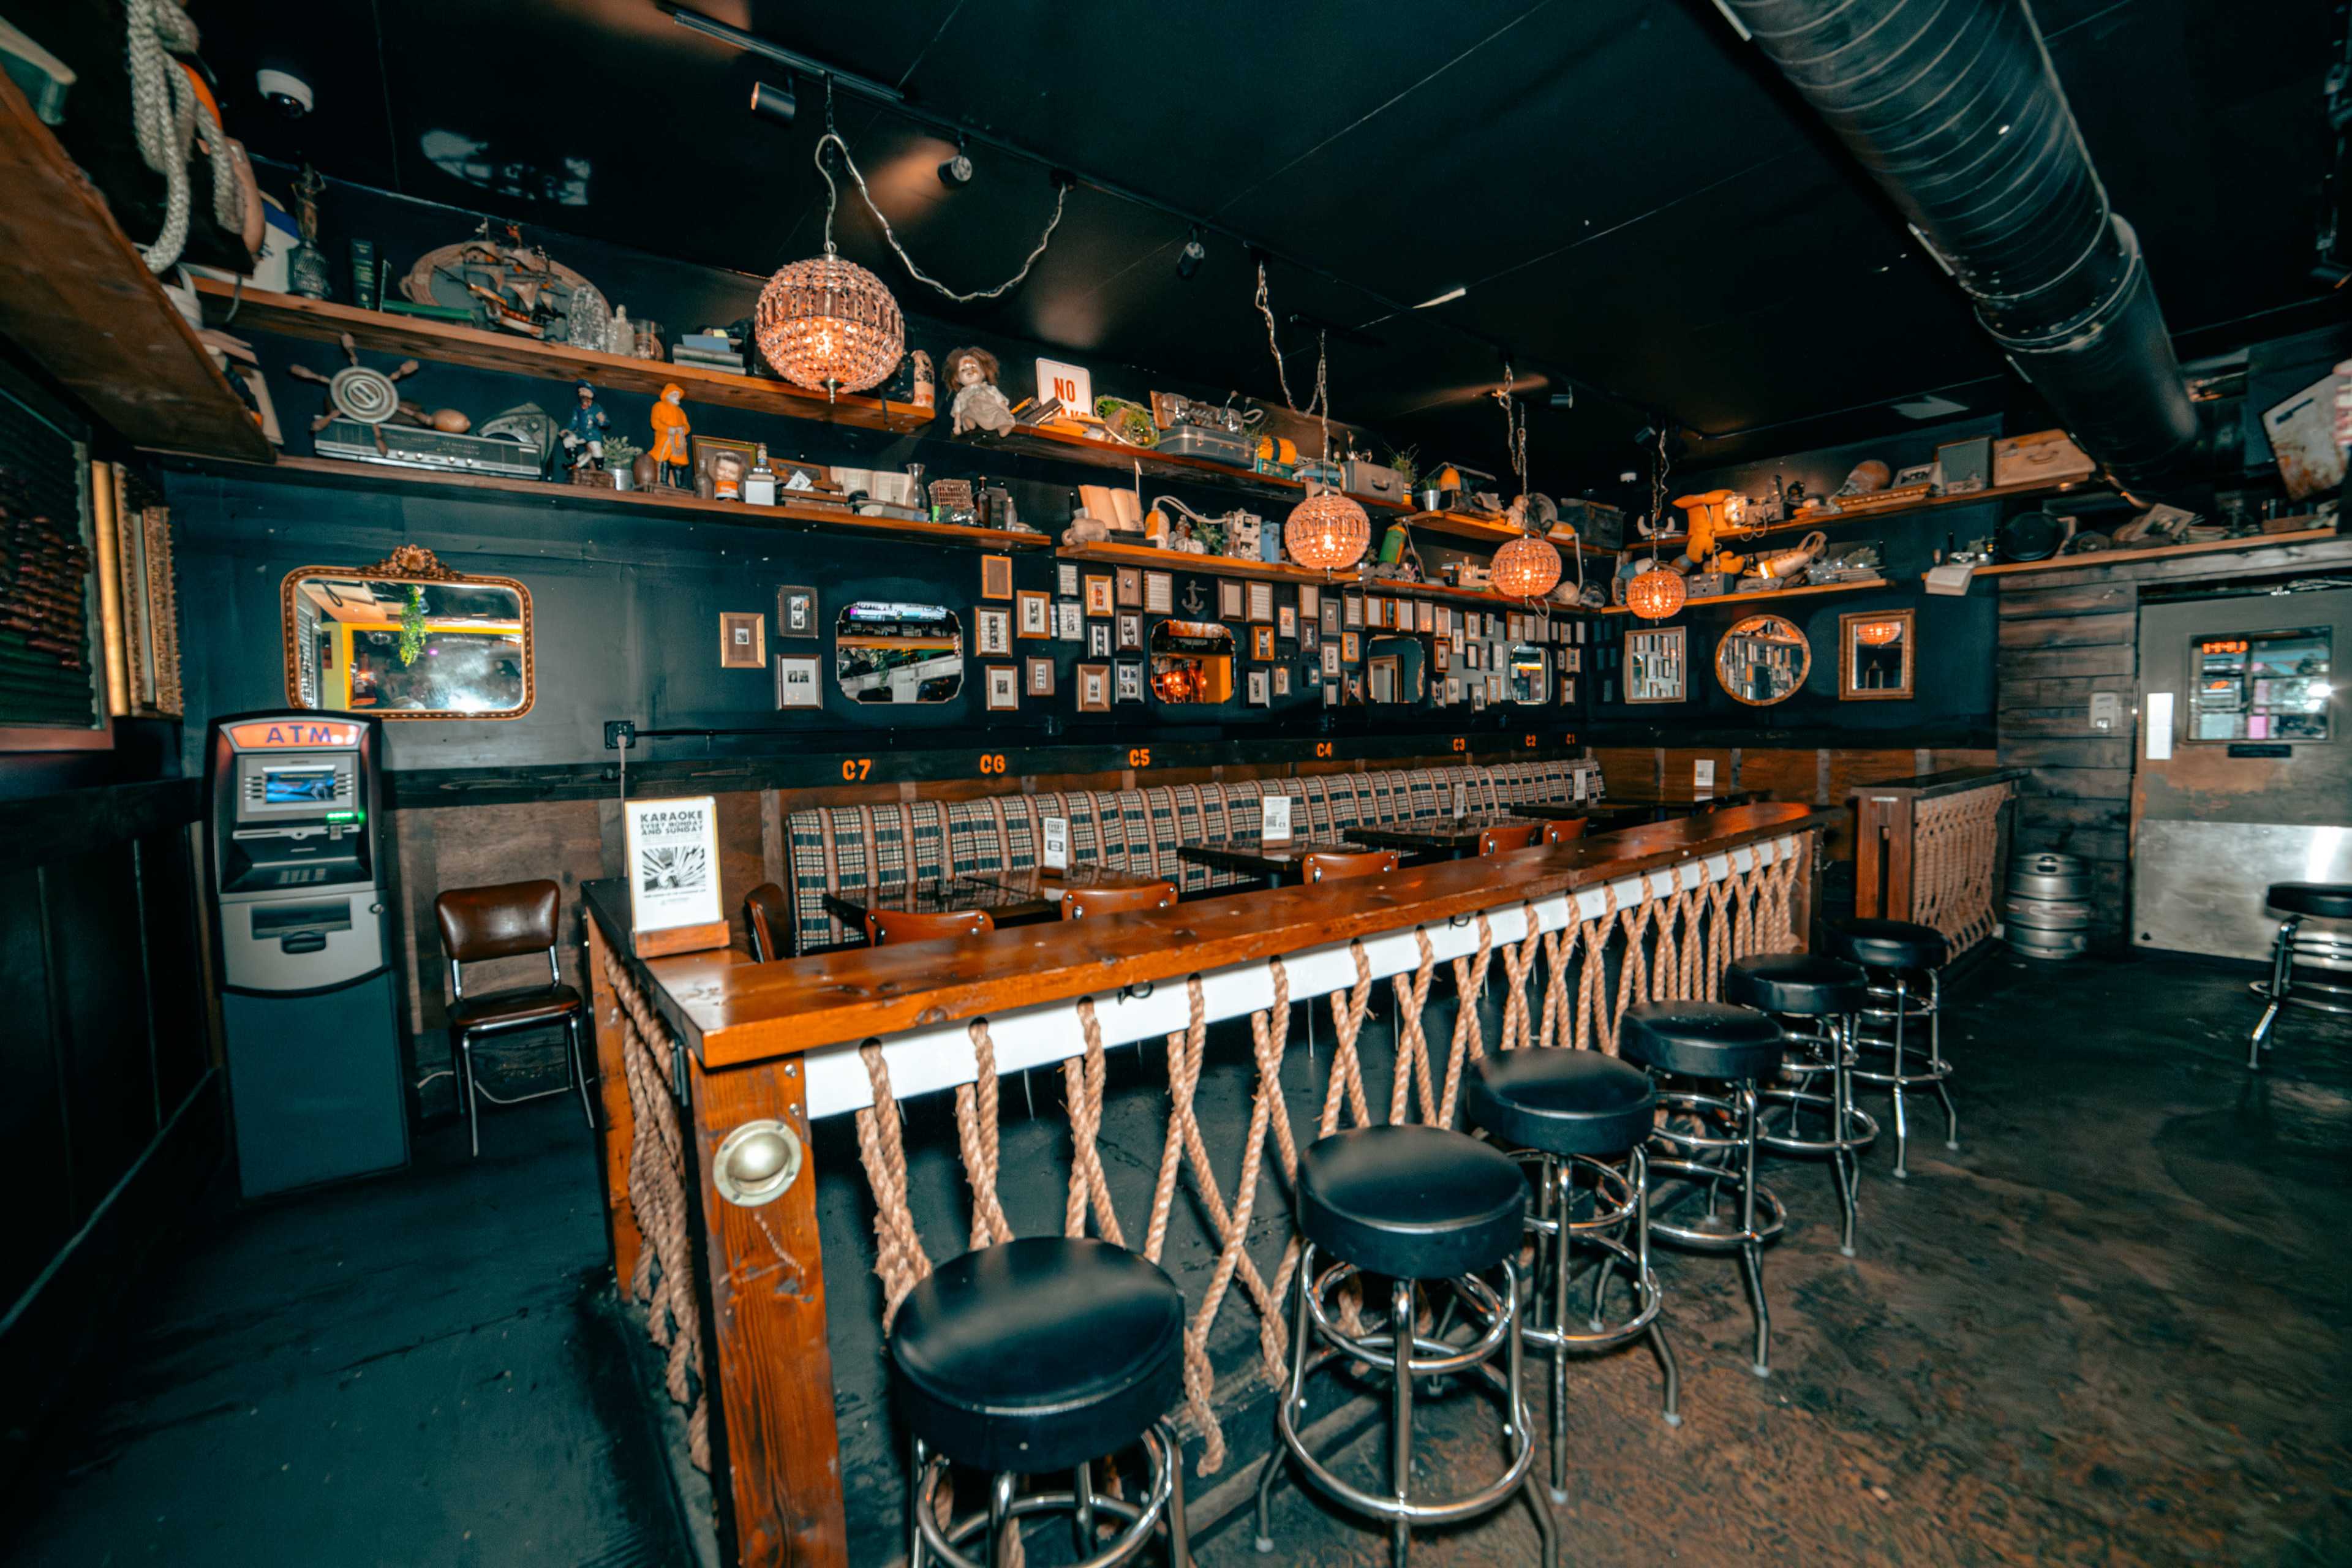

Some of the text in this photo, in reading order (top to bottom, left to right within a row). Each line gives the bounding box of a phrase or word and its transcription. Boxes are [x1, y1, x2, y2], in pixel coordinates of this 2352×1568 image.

[1054, 377, 1076, 402] NO
[266, 725, 332, 743] ATM
[1525, 735, 1536, 747] C2
[1566, 734, 1575, 745] C1
[1316, 742, 1333, 757] C4
[1452, 737, 1465, 751] C3
[979, 754, 1006, 774] C6
[1129, 748, 1150, 766] C5
[842, 759, 871, 780] C7
[640, 810, 703, 822] KARAOKE
